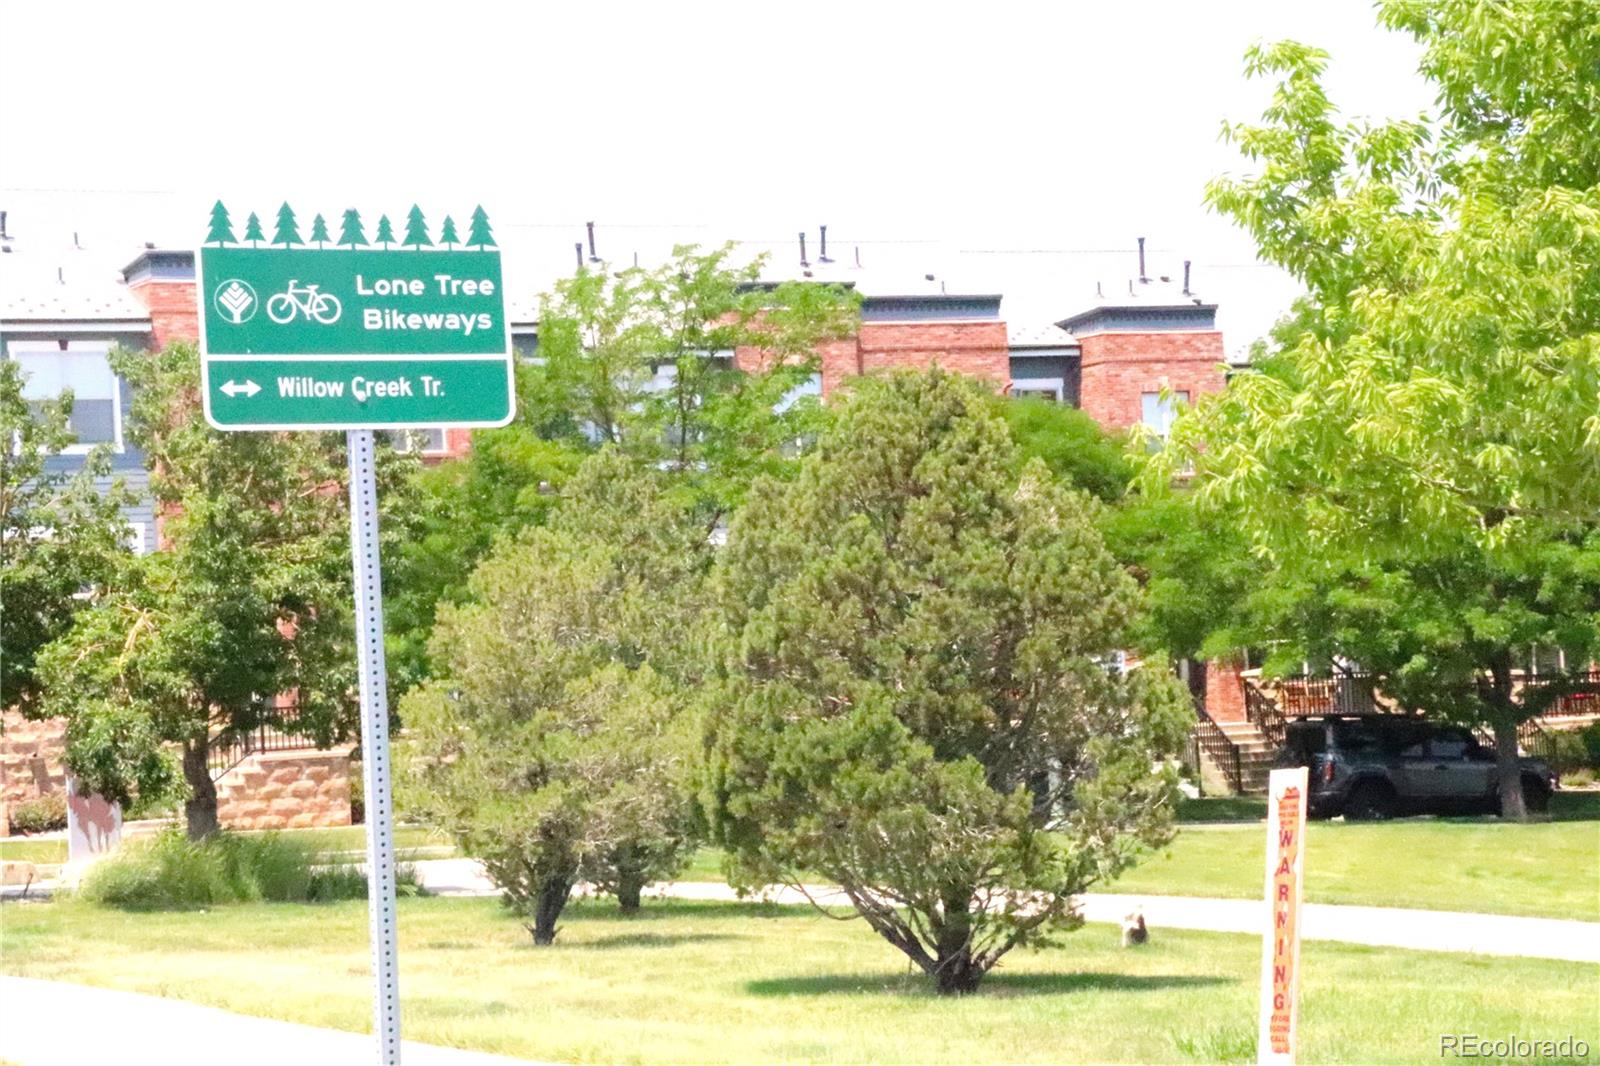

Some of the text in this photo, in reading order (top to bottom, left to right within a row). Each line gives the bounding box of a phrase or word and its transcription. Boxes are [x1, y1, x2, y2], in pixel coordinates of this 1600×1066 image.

[355, 274, 495, 296] Lone Tree
[362, 308, 493, 335] Bikeways
[277, 376, 445, 398] Willow Creek Tr.
[1273, 829, 1293, 1010] WARNING
